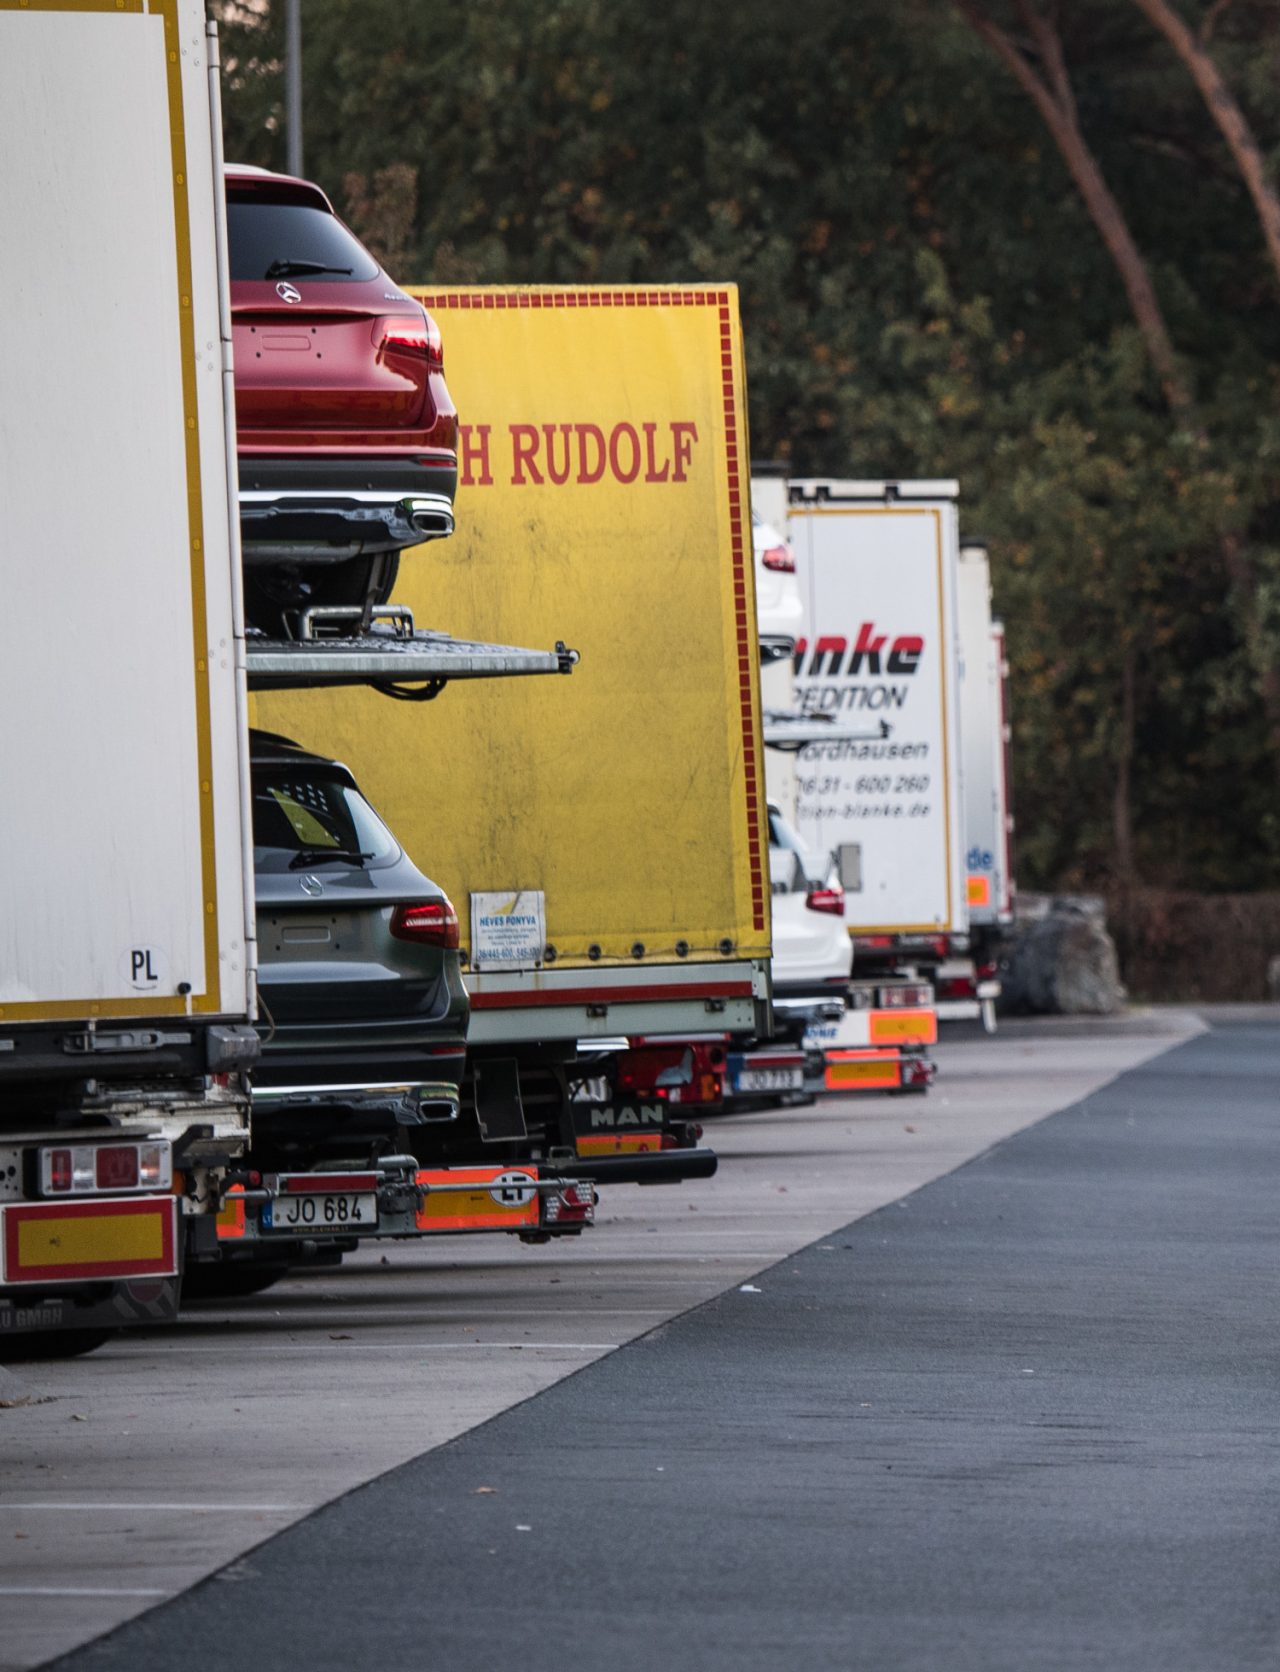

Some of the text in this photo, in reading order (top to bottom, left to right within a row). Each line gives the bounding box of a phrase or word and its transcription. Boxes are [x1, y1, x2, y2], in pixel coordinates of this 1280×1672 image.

[508, 421, 699, 486] RUDOLF
[796, 740, 928, 761] ordhausen
[131, 949, 158, 981] PL
[591, 1104, 663, 1127] MAN
[287, 1197, 361, 1224] JO 684
